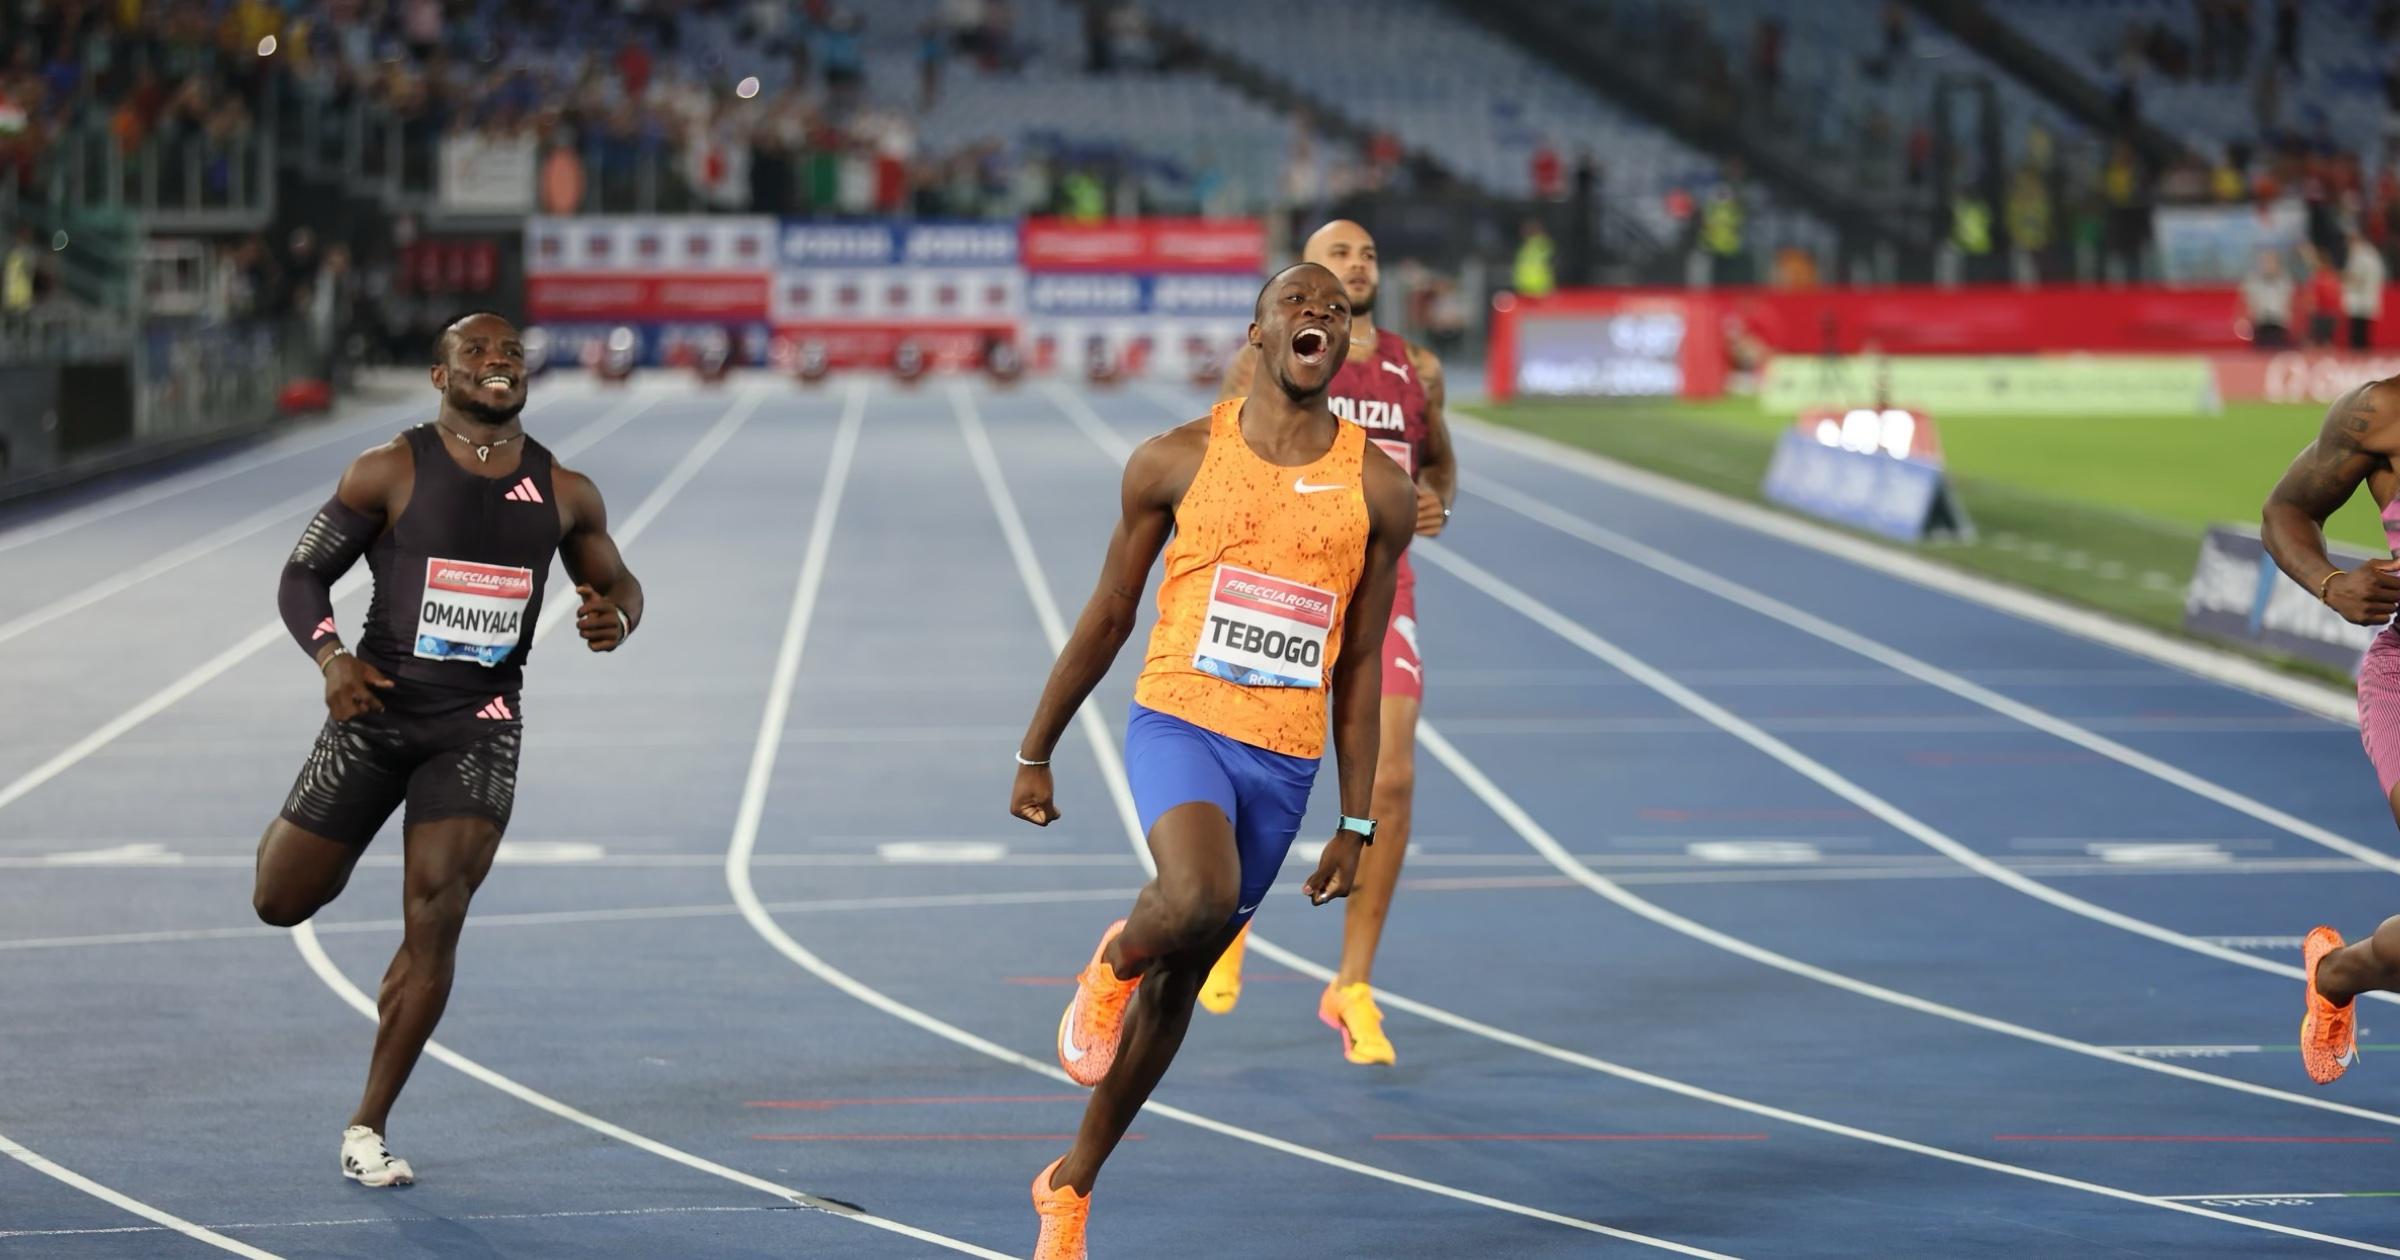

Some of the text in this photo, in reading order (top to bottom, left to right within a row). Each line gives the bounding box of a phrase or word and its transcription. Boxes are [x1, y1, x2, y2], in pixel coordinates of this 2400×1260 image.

[436, 568, 528, 587] FRECCIAROSSA
[1226, 580, 1329, 614] FRECCIAROSSA
[422, 601, 518, 633] OMANYALA
[1210, 615, 1321, 667] TEBOGO
